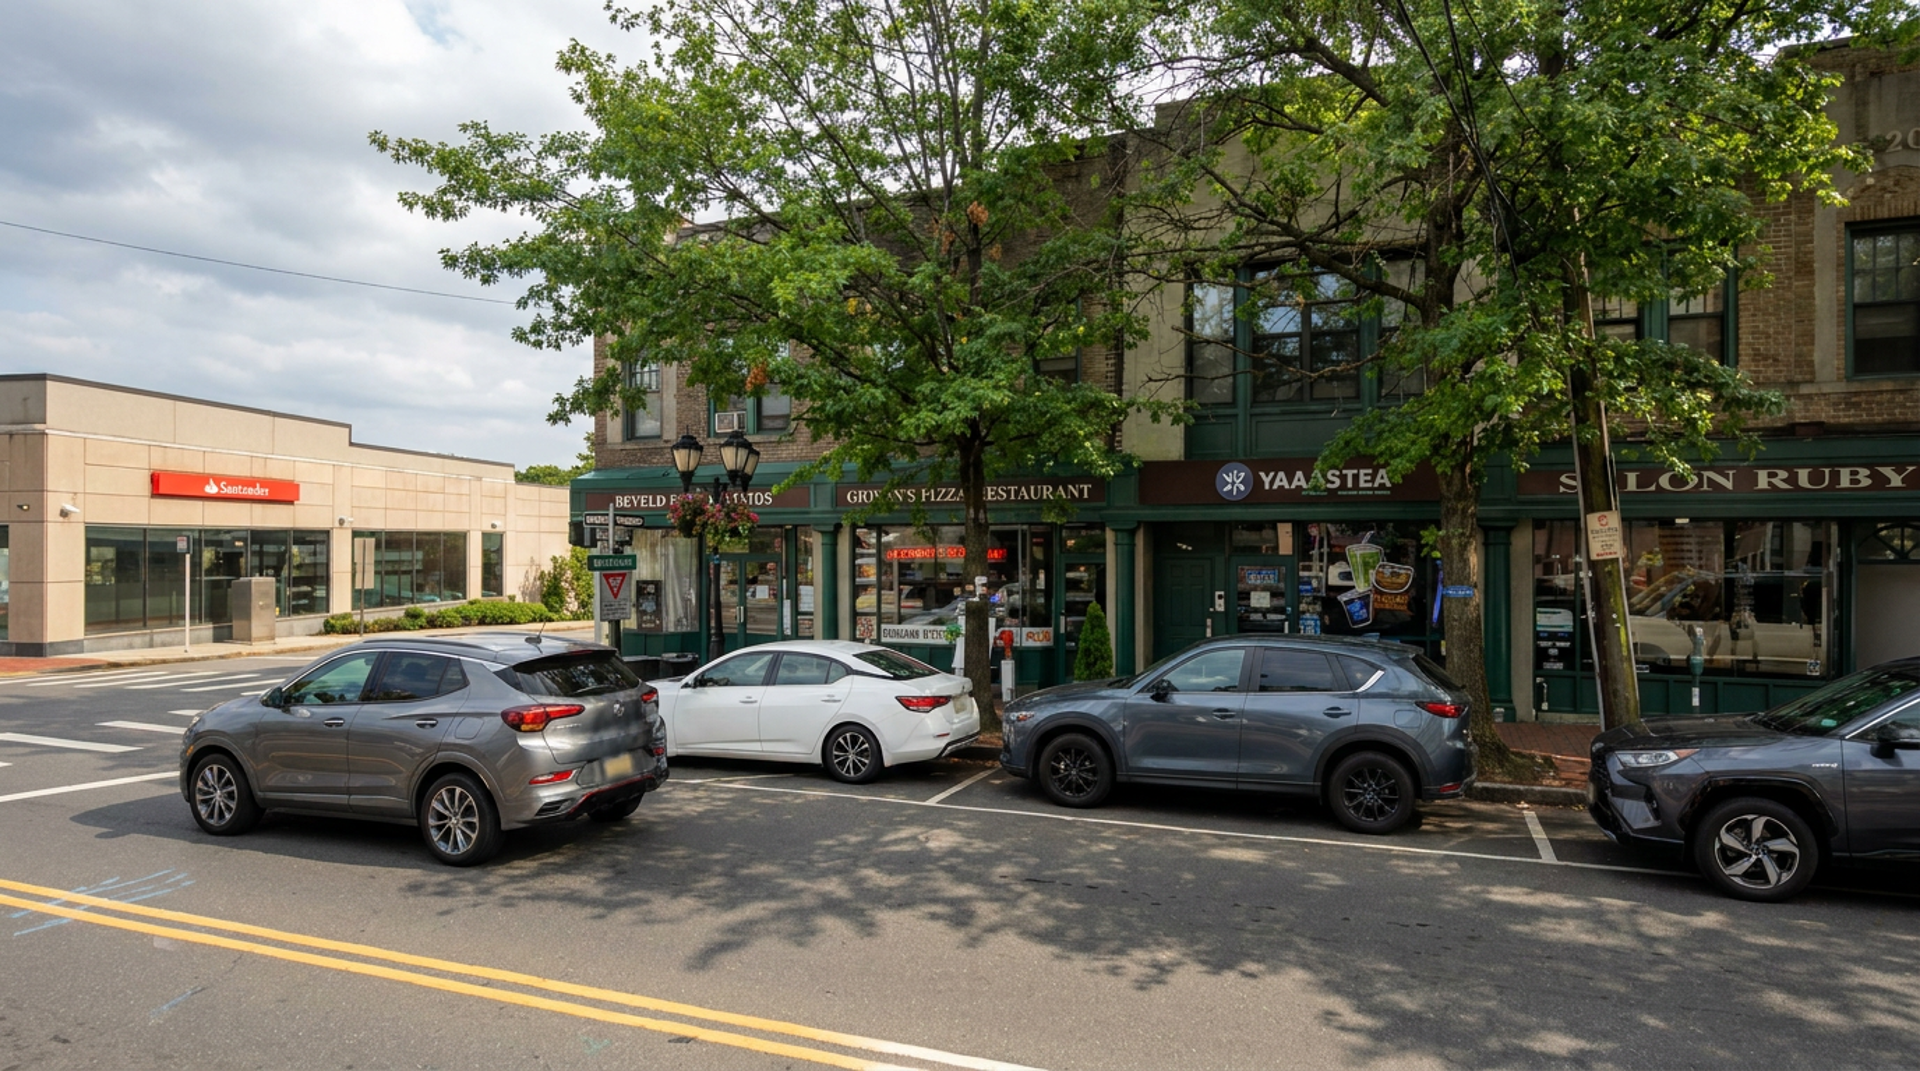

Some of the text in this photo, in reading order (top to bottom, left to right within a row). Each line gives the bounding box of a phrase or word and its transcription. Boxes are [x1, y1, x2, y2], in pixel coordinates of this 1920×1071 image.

[1559, 466, 1918, 492] SLON RUBY
[982, 484, 1092, 501] ESTAURANT
